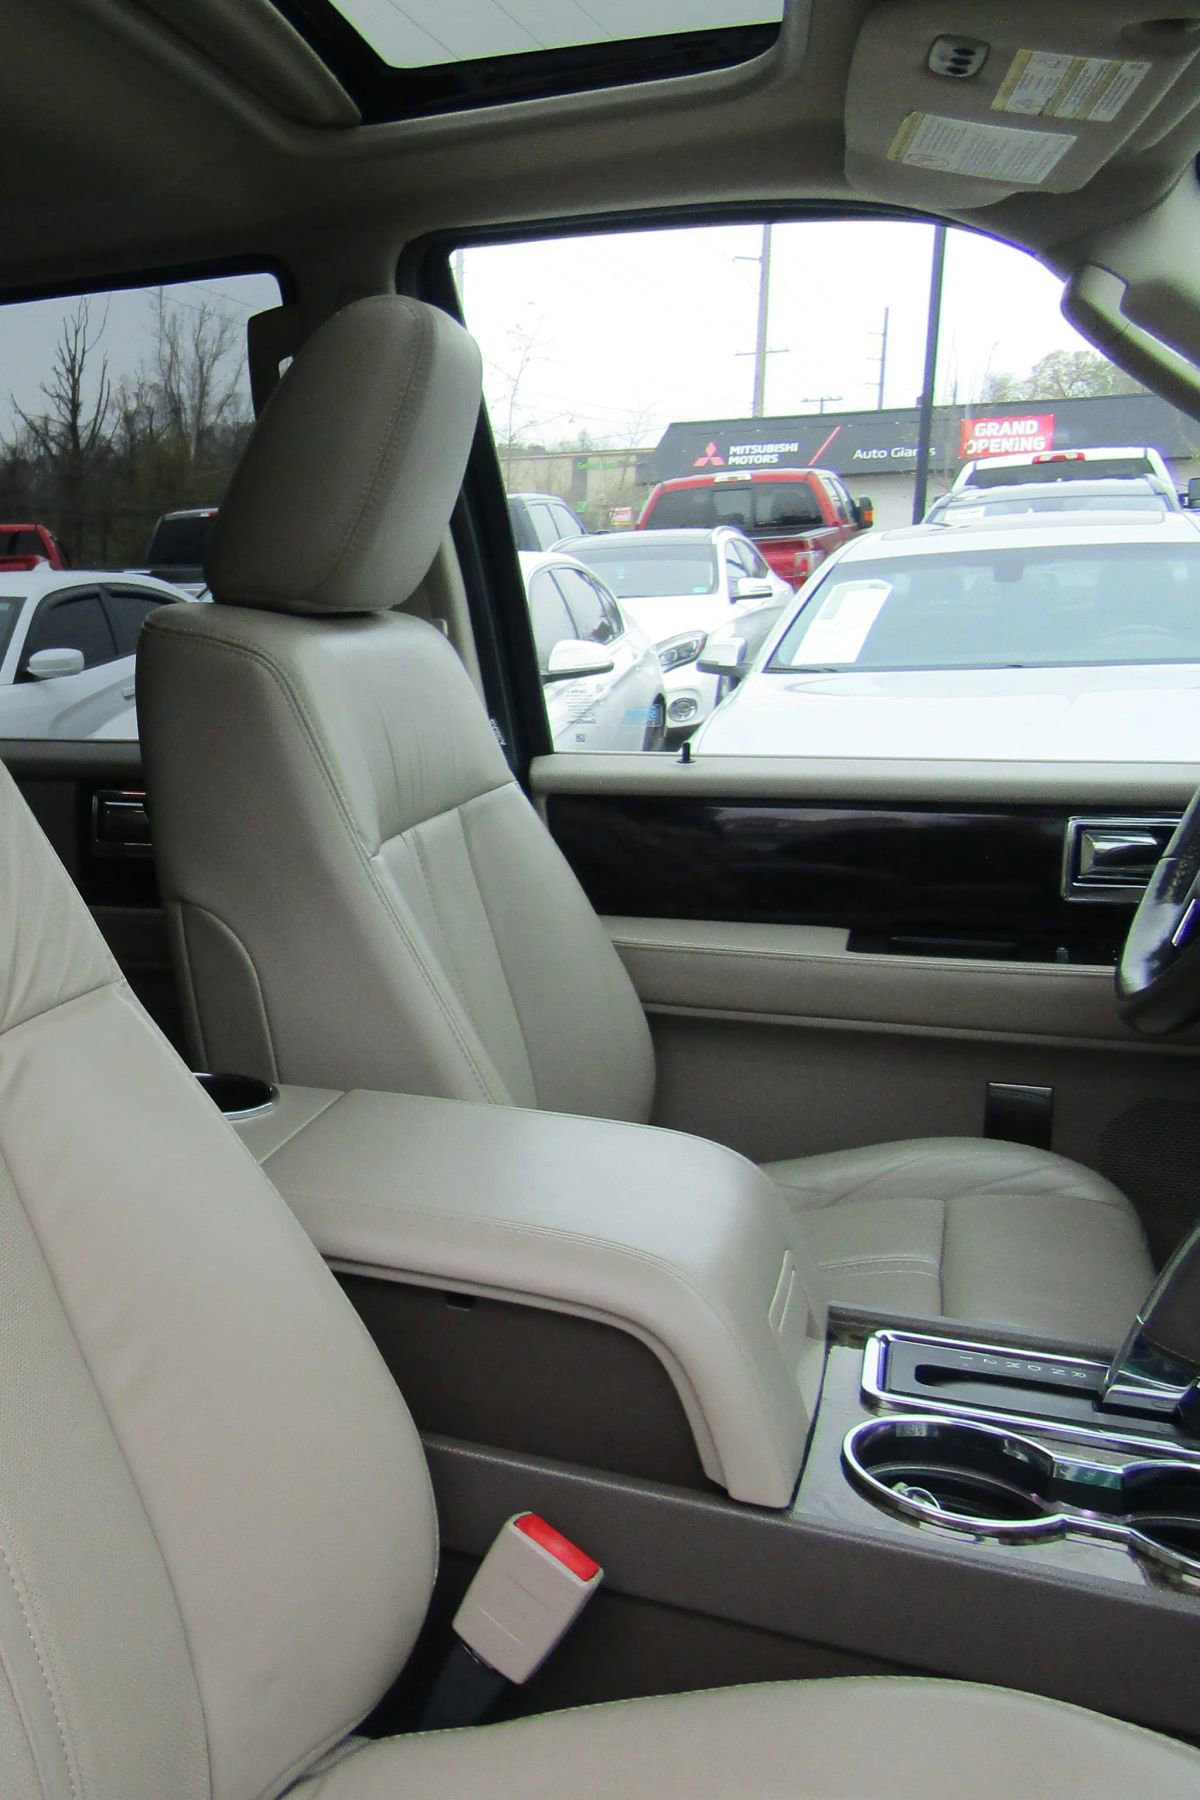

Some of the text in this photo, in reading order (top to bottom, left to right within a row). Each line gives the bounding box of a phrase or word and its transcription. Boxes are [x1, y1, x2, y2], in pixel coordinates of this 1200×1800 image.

[974, 420, 1039, 437] GRAND
[729, 442, 799, 455] MITSUBISHI
[965, 436, 1046, 455] OPENING
[728, 453, 779, 465] MOTORS
[852, 446, 936, 460] Auto Gians
